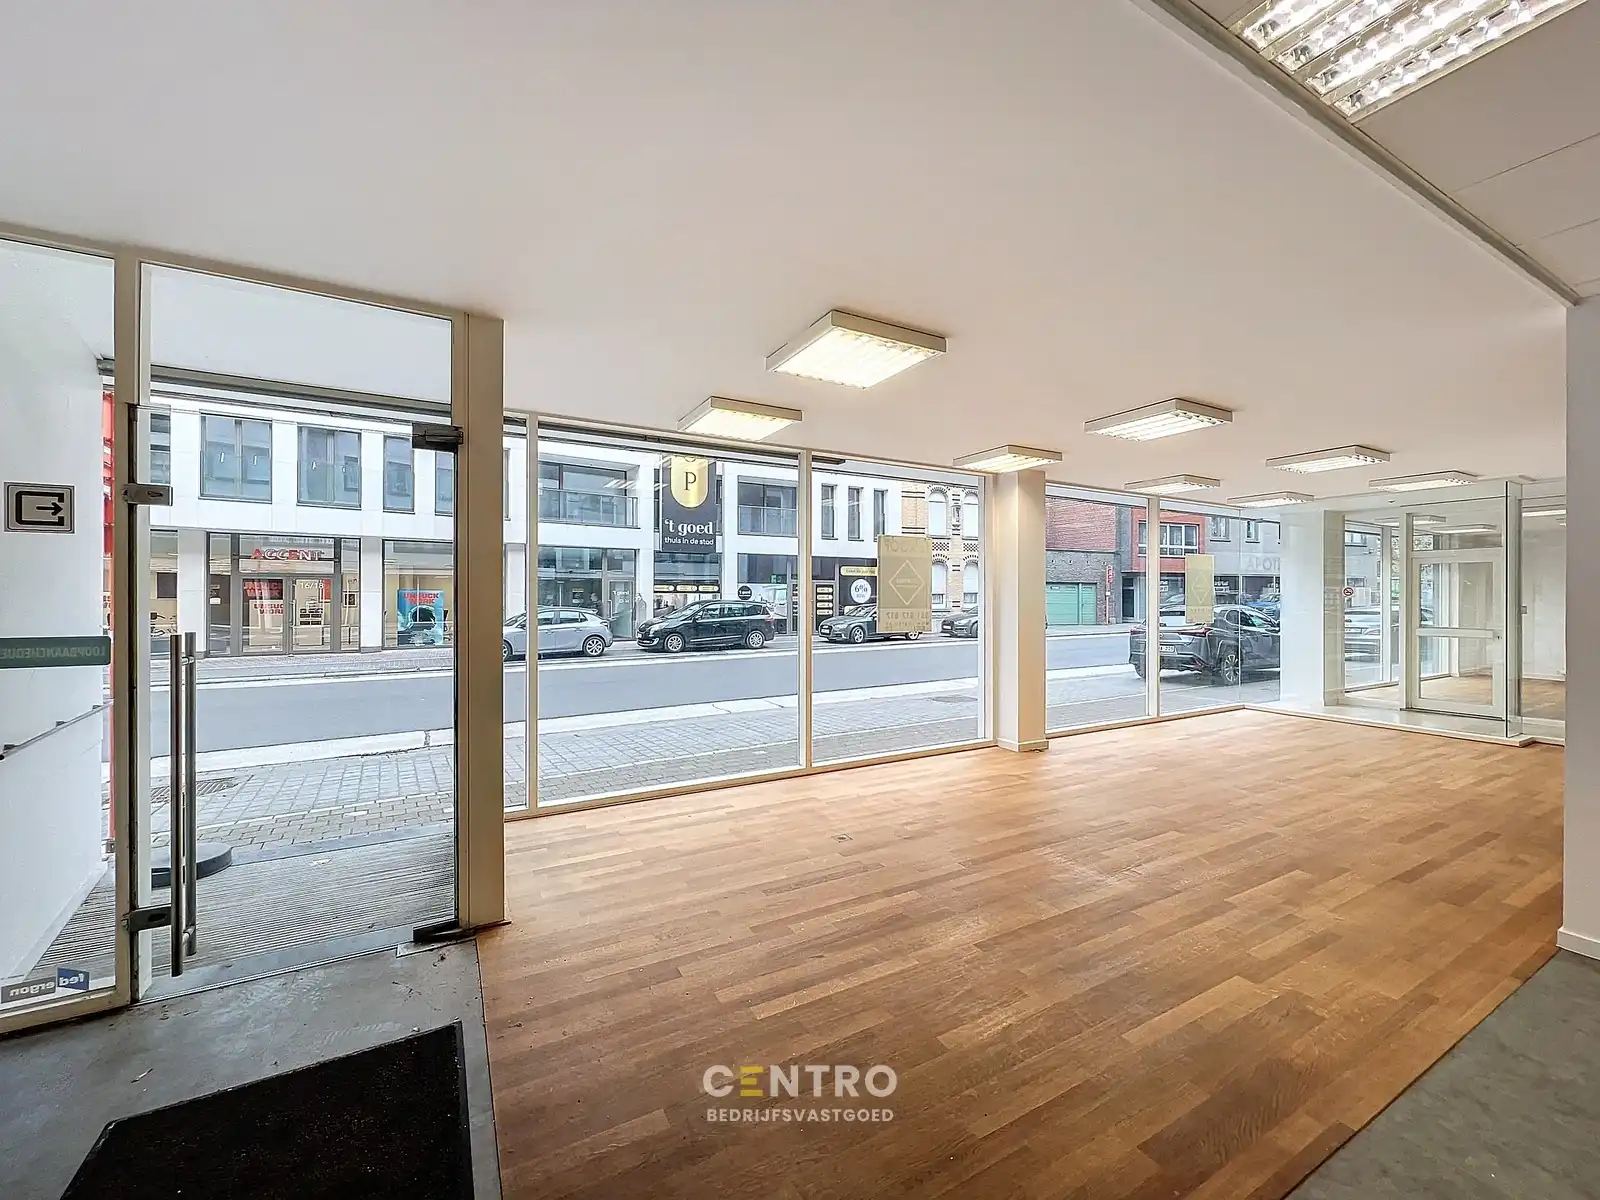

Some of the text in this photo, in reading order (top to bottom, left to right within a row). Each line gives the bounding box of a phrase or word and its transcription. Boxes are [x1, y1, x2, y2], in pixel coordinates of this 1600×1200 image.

[684, 471, 697, 491] P
[678, 521, 714, 537] goed
[251, 549, 323, 561] ACCENT
[854, 584, 868, 593] 6%
